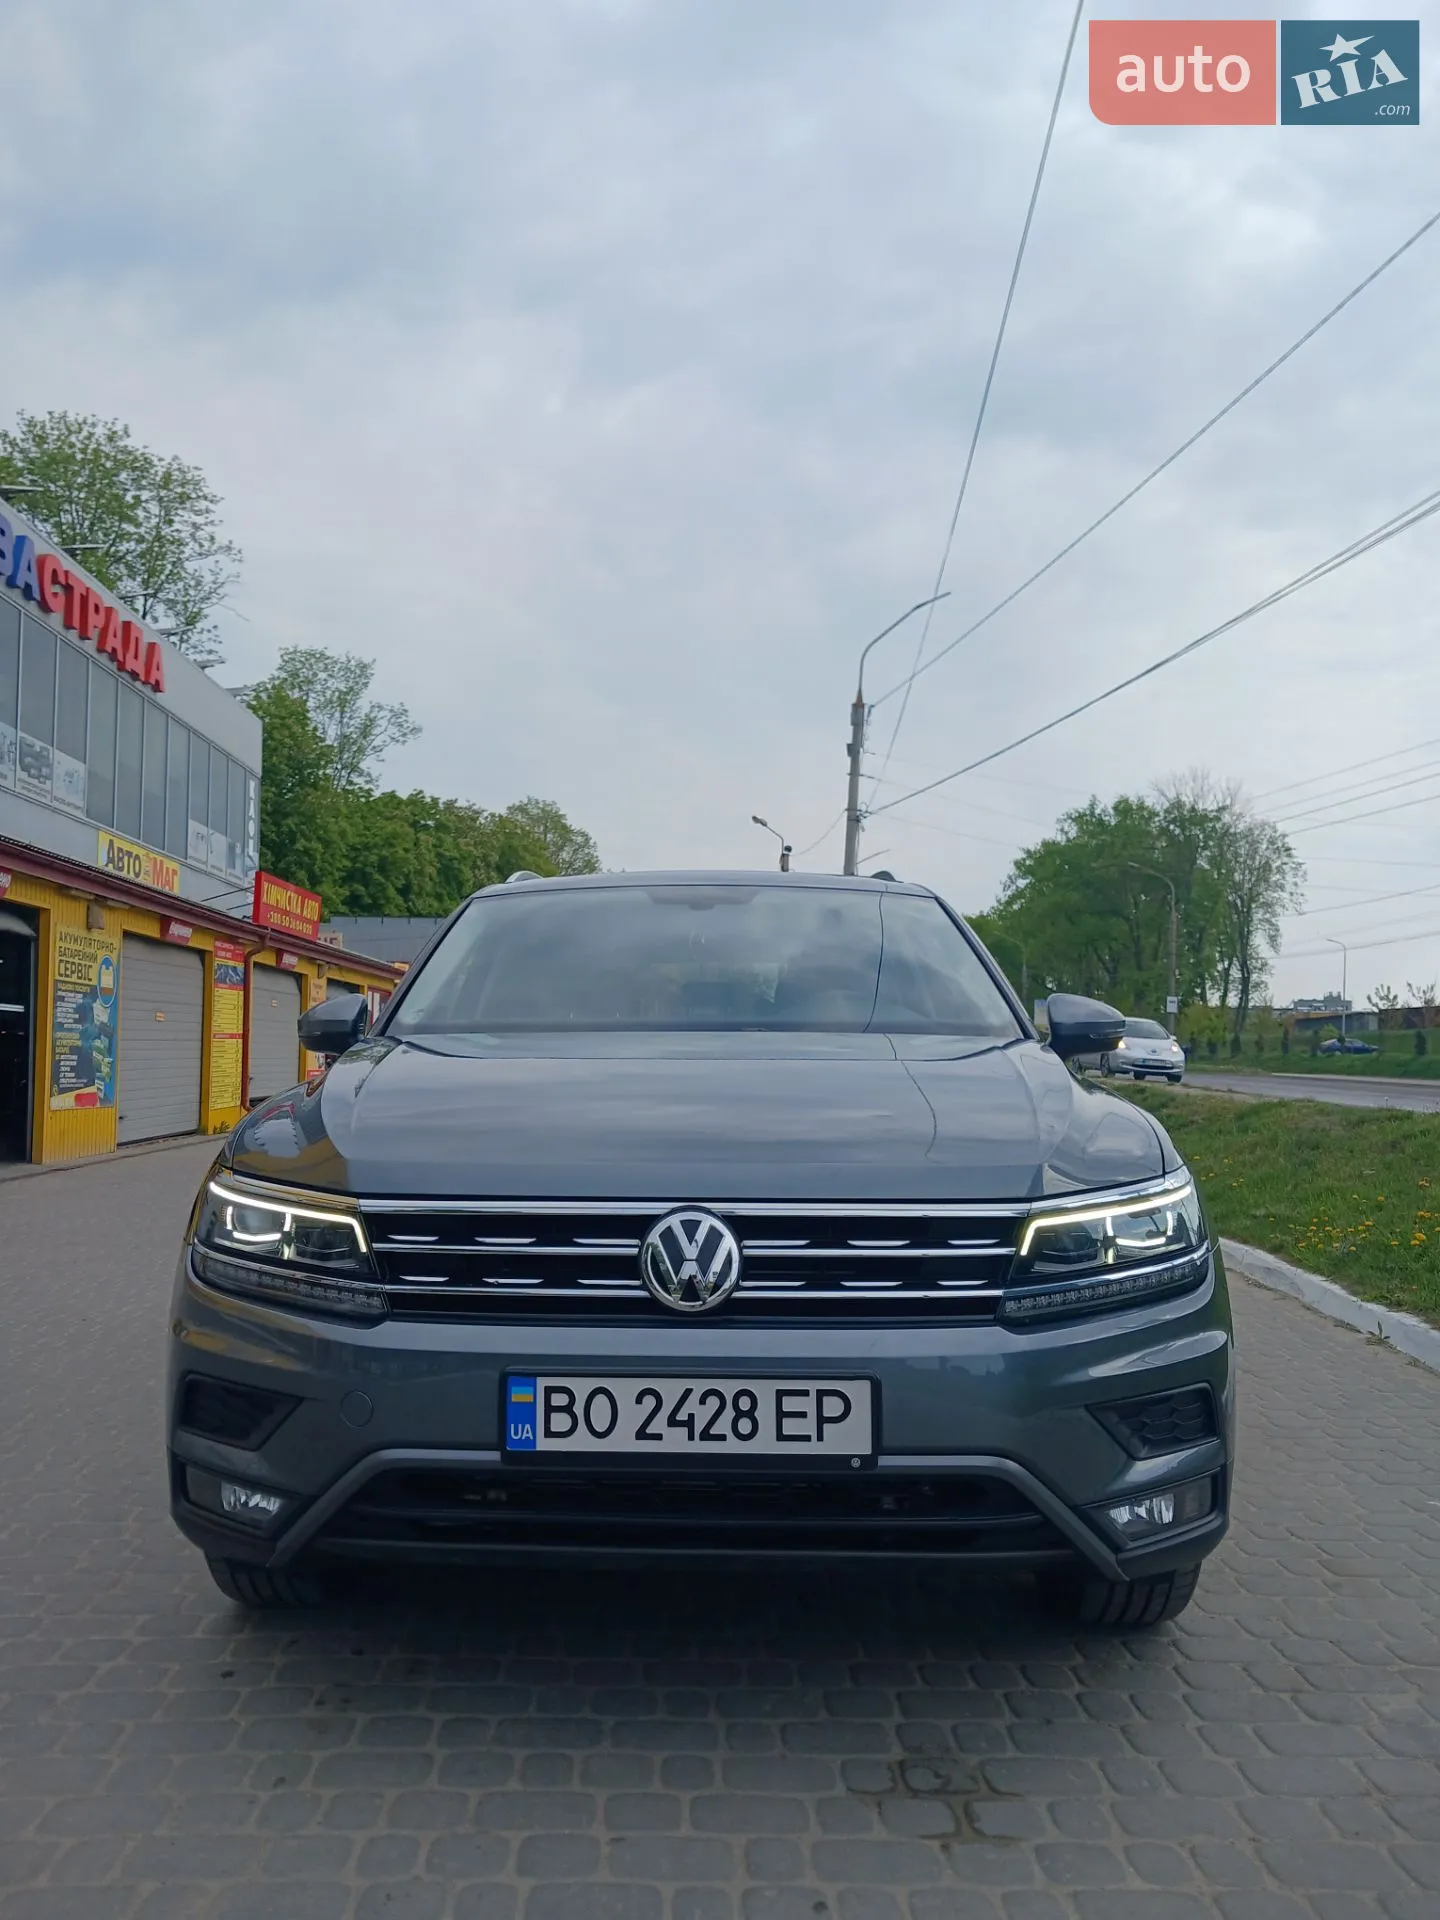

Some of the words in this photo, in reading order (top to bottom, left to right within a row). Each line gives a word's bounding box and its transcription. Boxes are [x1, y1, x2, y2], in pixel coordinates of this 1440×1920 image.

[303, 898, 319, 921] АВТО
[58, 930, 117, 954] АКУМУЛЯТОРНО-
[57, 959, 93, 982] СЕРВІС
[543, 1385, 619, 1439] BO
[634, 1387, 760, 1441] 2428
[775, 1388, 852, 1442] EP
[510, 1423, 534, 1440] UA
